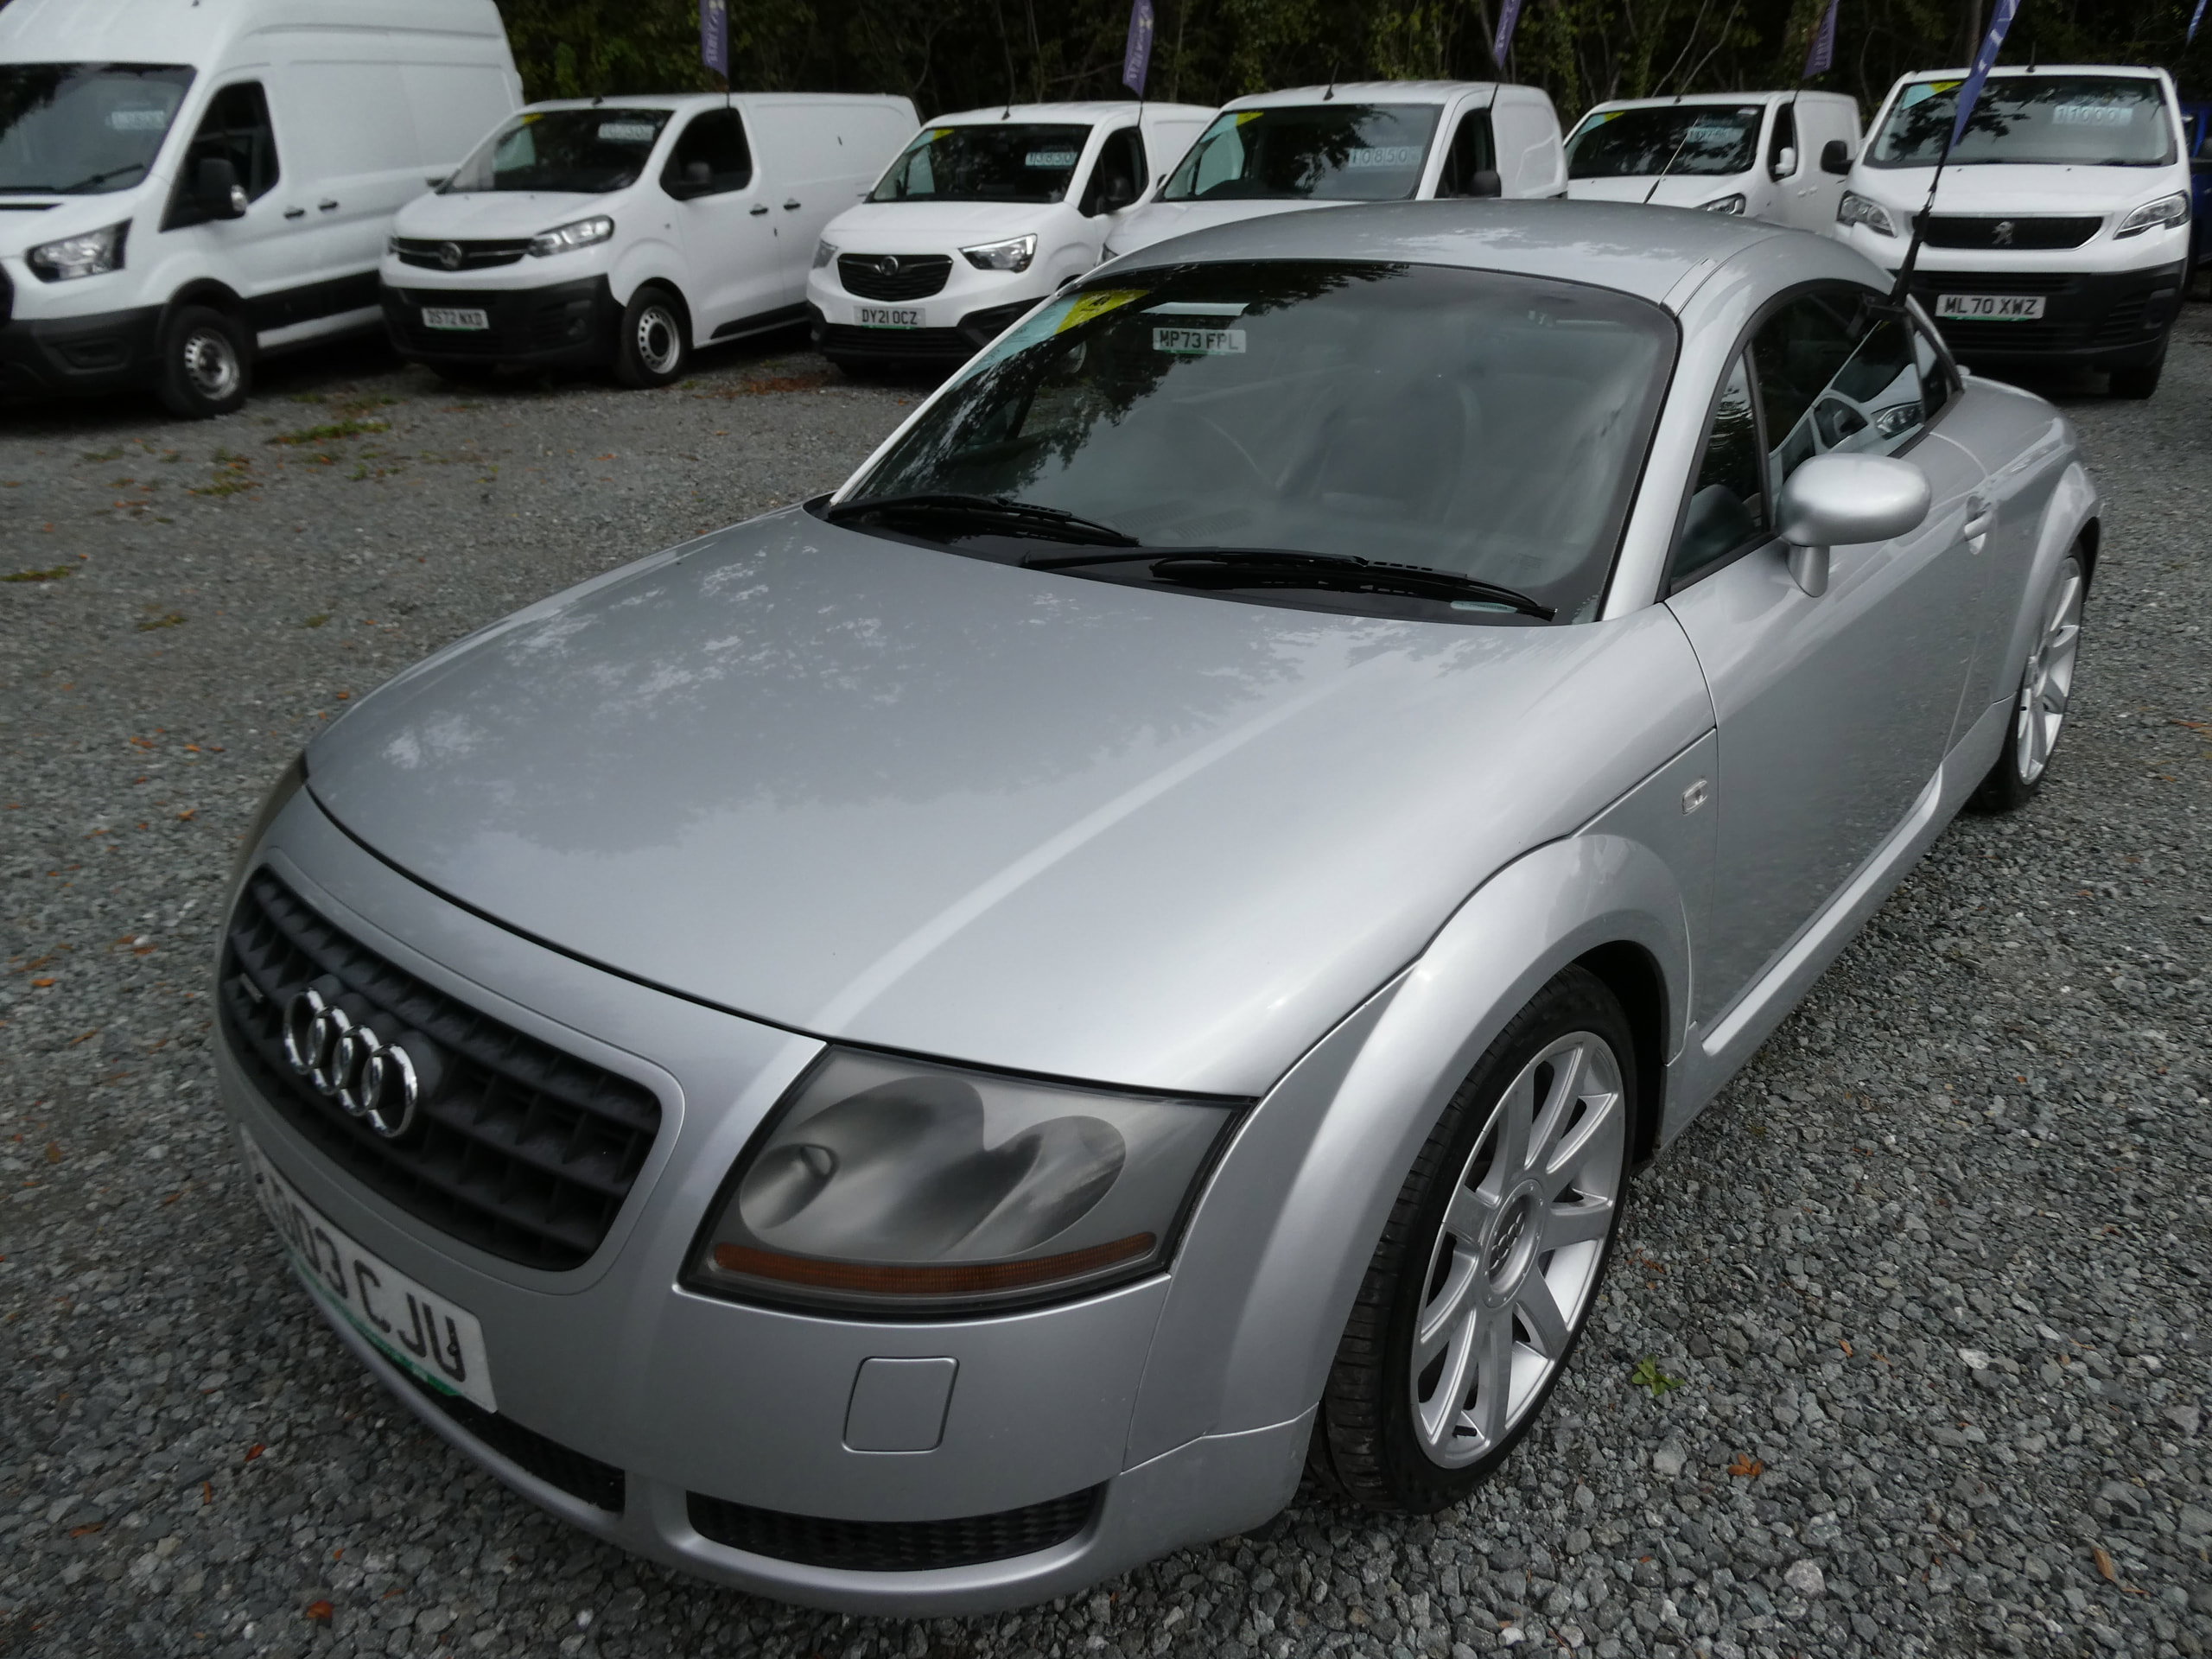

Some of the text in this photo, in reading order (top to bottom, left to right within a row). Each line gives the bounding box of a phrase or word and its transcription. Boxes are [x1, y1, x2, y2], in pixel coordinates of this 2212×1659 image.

[1351, 149, 1408, 165] 10850
[1944, 296, 2037, 315] ML70 XWZ
[861, 309, 918, 325] DY21 OCZ
[1160, 329, 1202, 349] MP73
